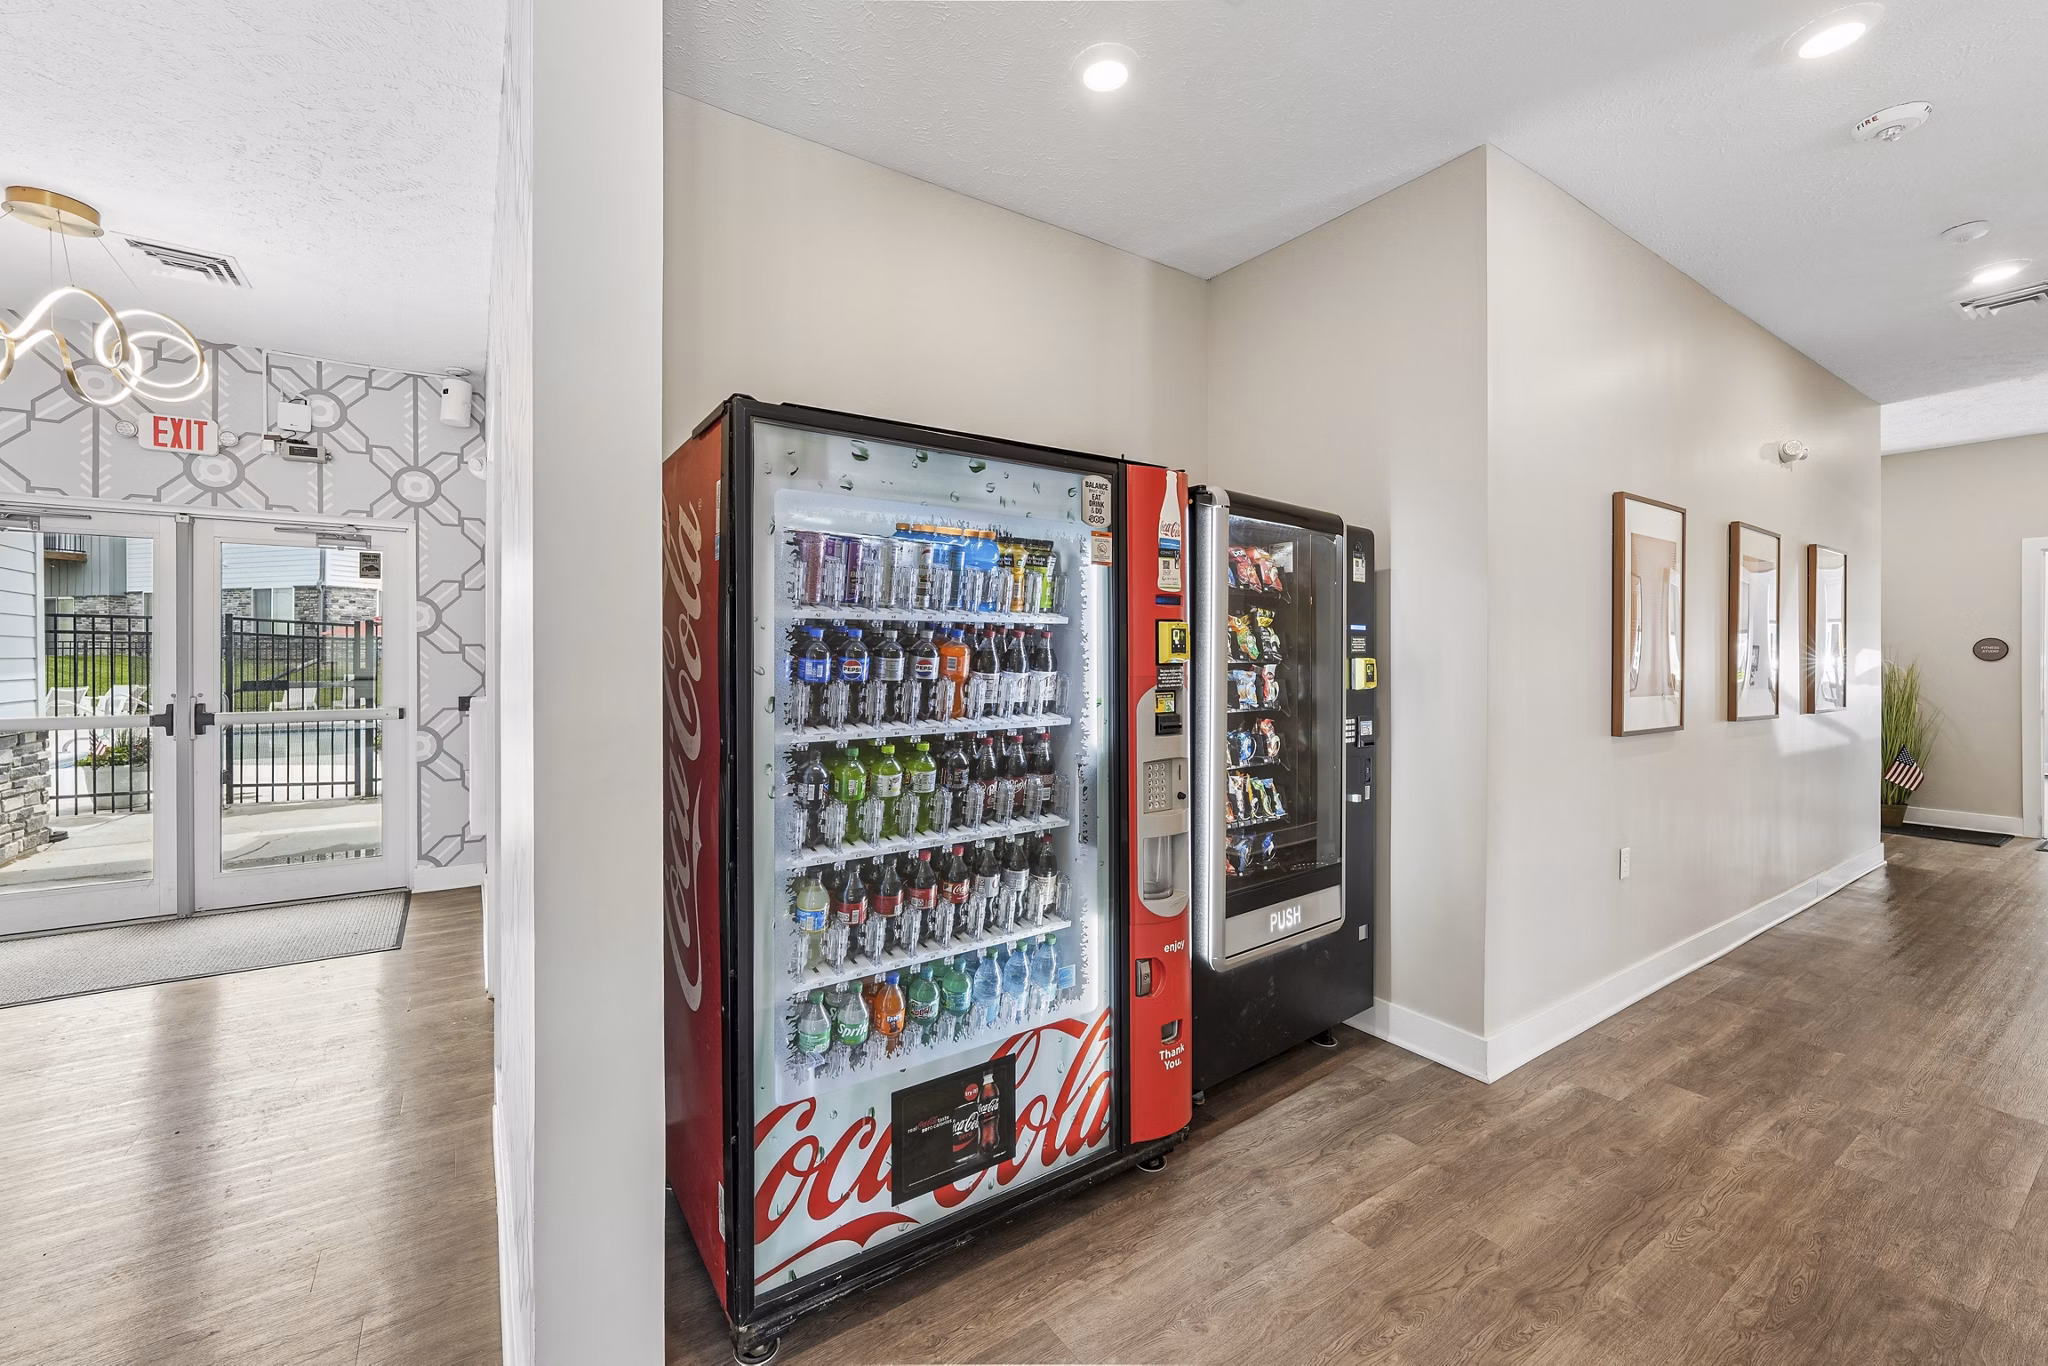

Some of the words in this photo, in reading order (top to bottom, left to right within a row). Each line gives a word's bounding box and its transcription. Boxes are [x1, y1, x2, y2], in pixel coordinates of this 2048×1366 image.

[1856, 115, 1879, 131] FIRE
[153, 415, 208, 451] EXIT
[1085, 481, 1108, 491] BALANCE
[1089, 500, 1105, 508] DRINK
[1270, 904, 1301, 933] PUSH
[1164, 940, 1185, 952] enjoy
[1159, 1043, 1185, 1060] Thank
[1164, 1058, 1182, 1070] You.
[933, 1119, 952, 1129] calories
[937, 1115, 950, 1123] taste
[959, 1131, 973, 1141] zero
